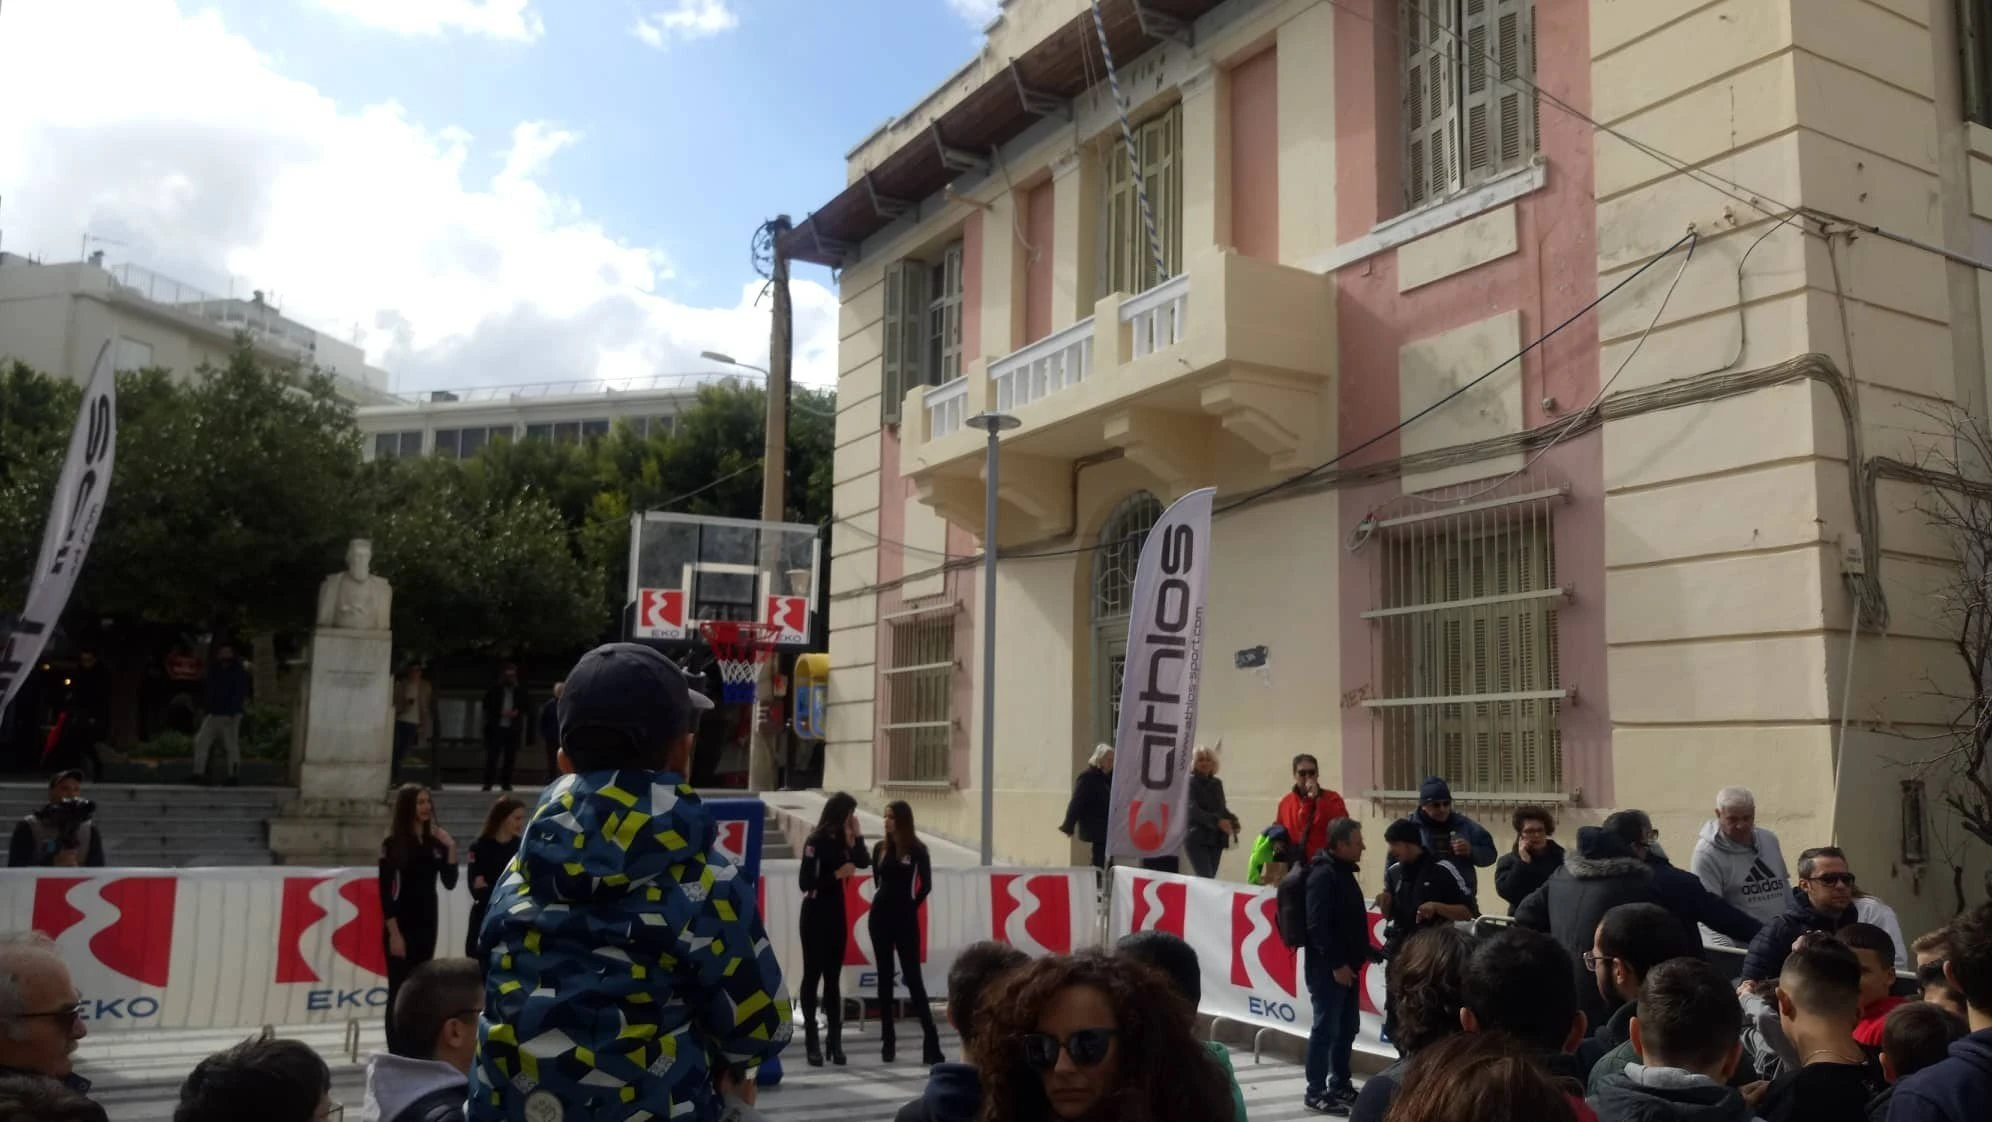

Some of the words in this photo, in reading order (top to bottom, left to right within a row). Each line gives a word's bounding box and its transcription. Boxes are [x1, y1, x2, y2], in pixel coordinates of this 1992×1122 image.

[651, 629, 680, 638] EKO
[1137, 524, 1194, 790] athlos
[1743, 878, 1784, 895] adidas
[308, 987, 390, 1010] EKO
[1249, 995, 1296, 1022] EKO
